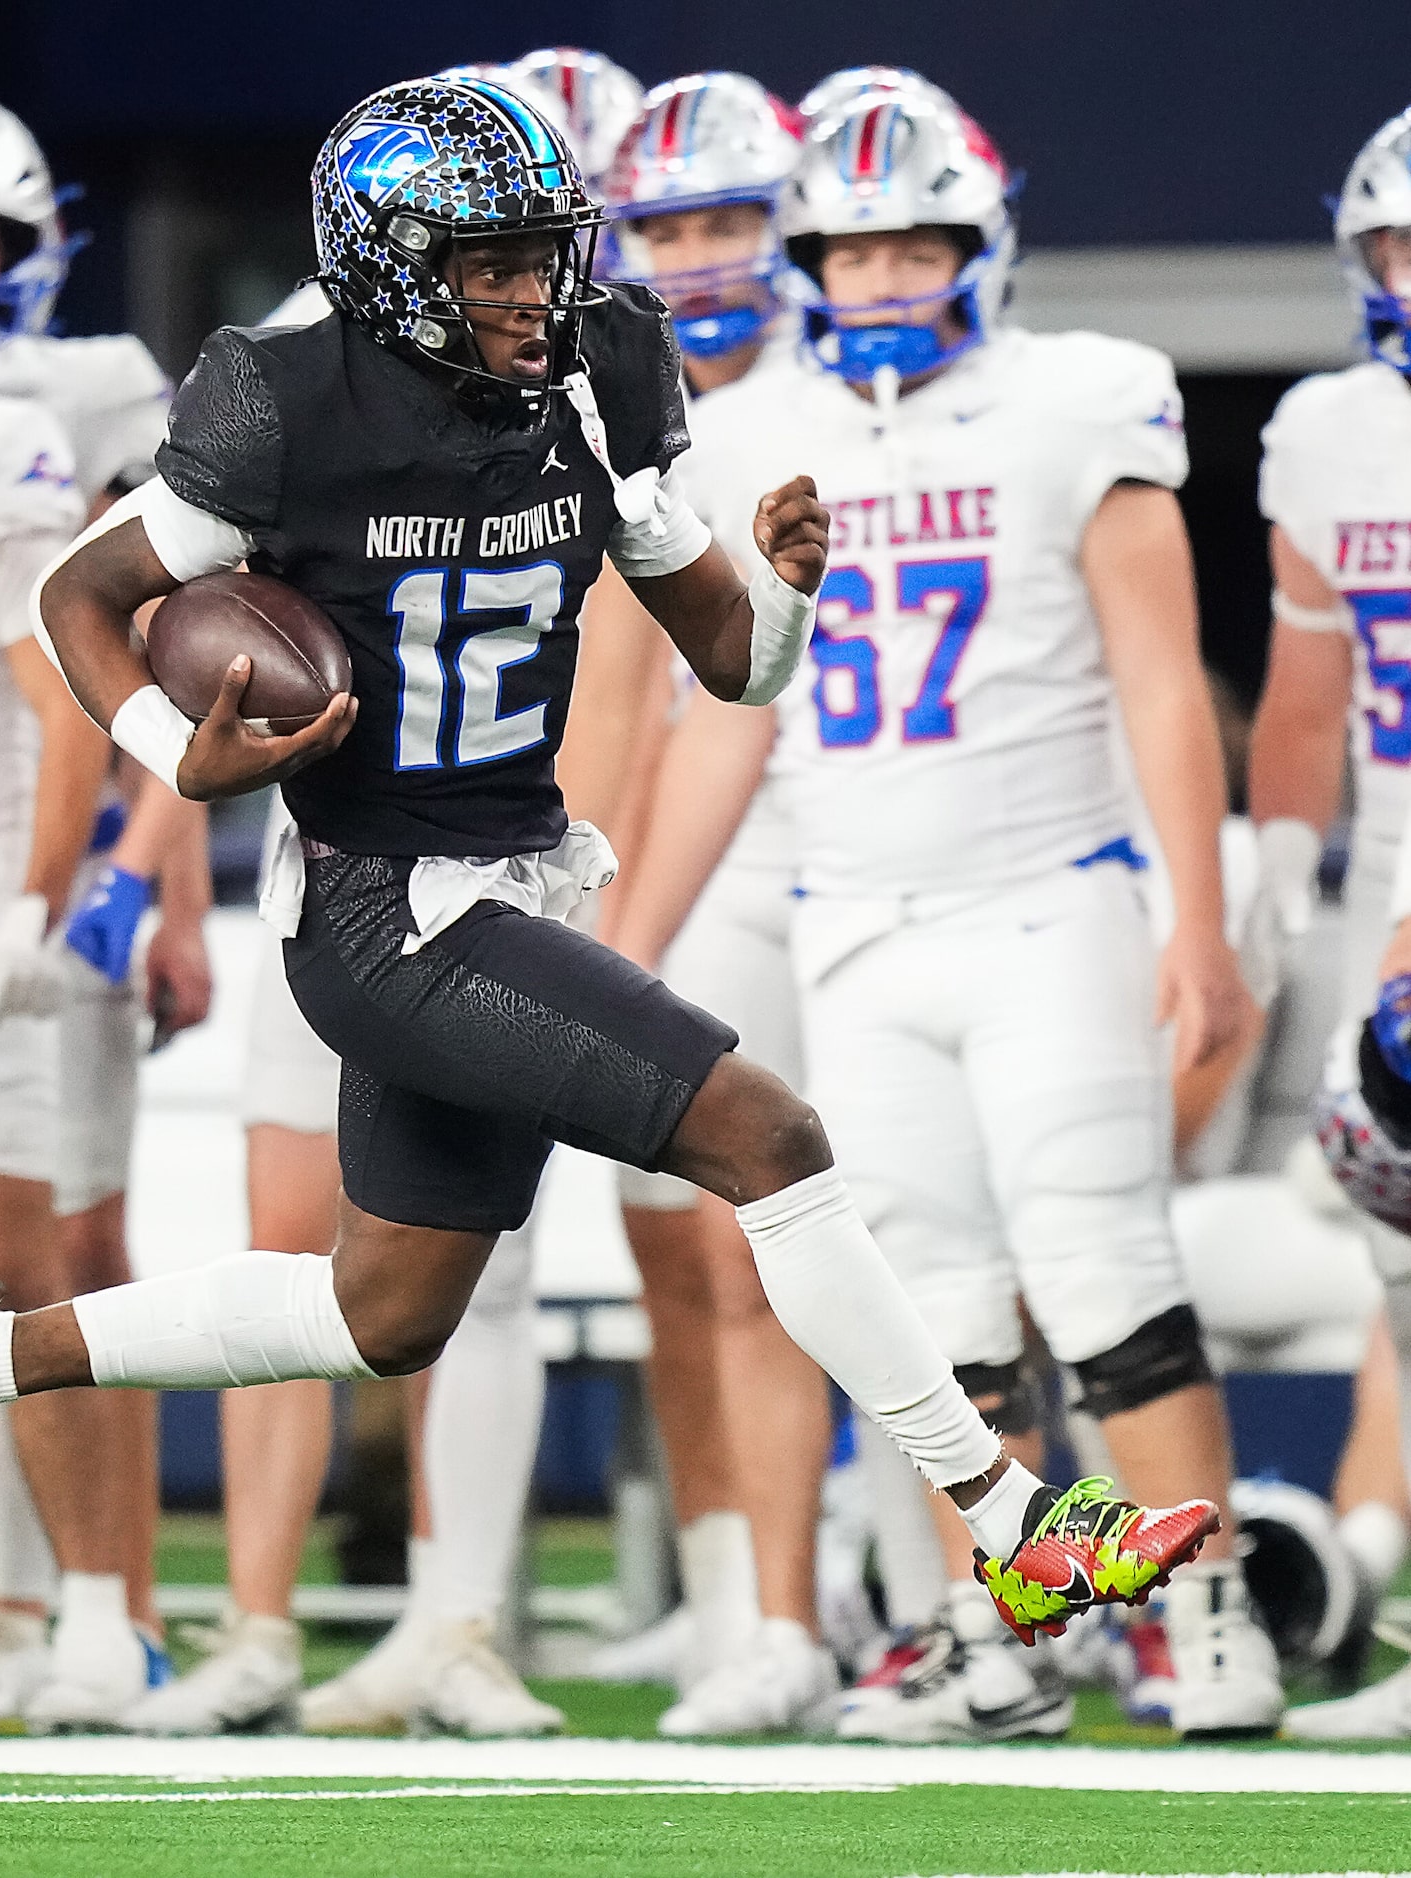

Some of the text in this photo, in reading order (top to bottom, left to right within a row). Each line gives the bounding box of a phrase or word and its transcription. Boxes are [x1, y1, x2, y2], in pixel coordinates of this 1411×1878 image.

[552, 267, 575, 325] Rddell
[365, 492, 583, 559] NORTH CROWLEY
[385, 558, 566, 773] 12
[807, 555, 992, 749] 67
